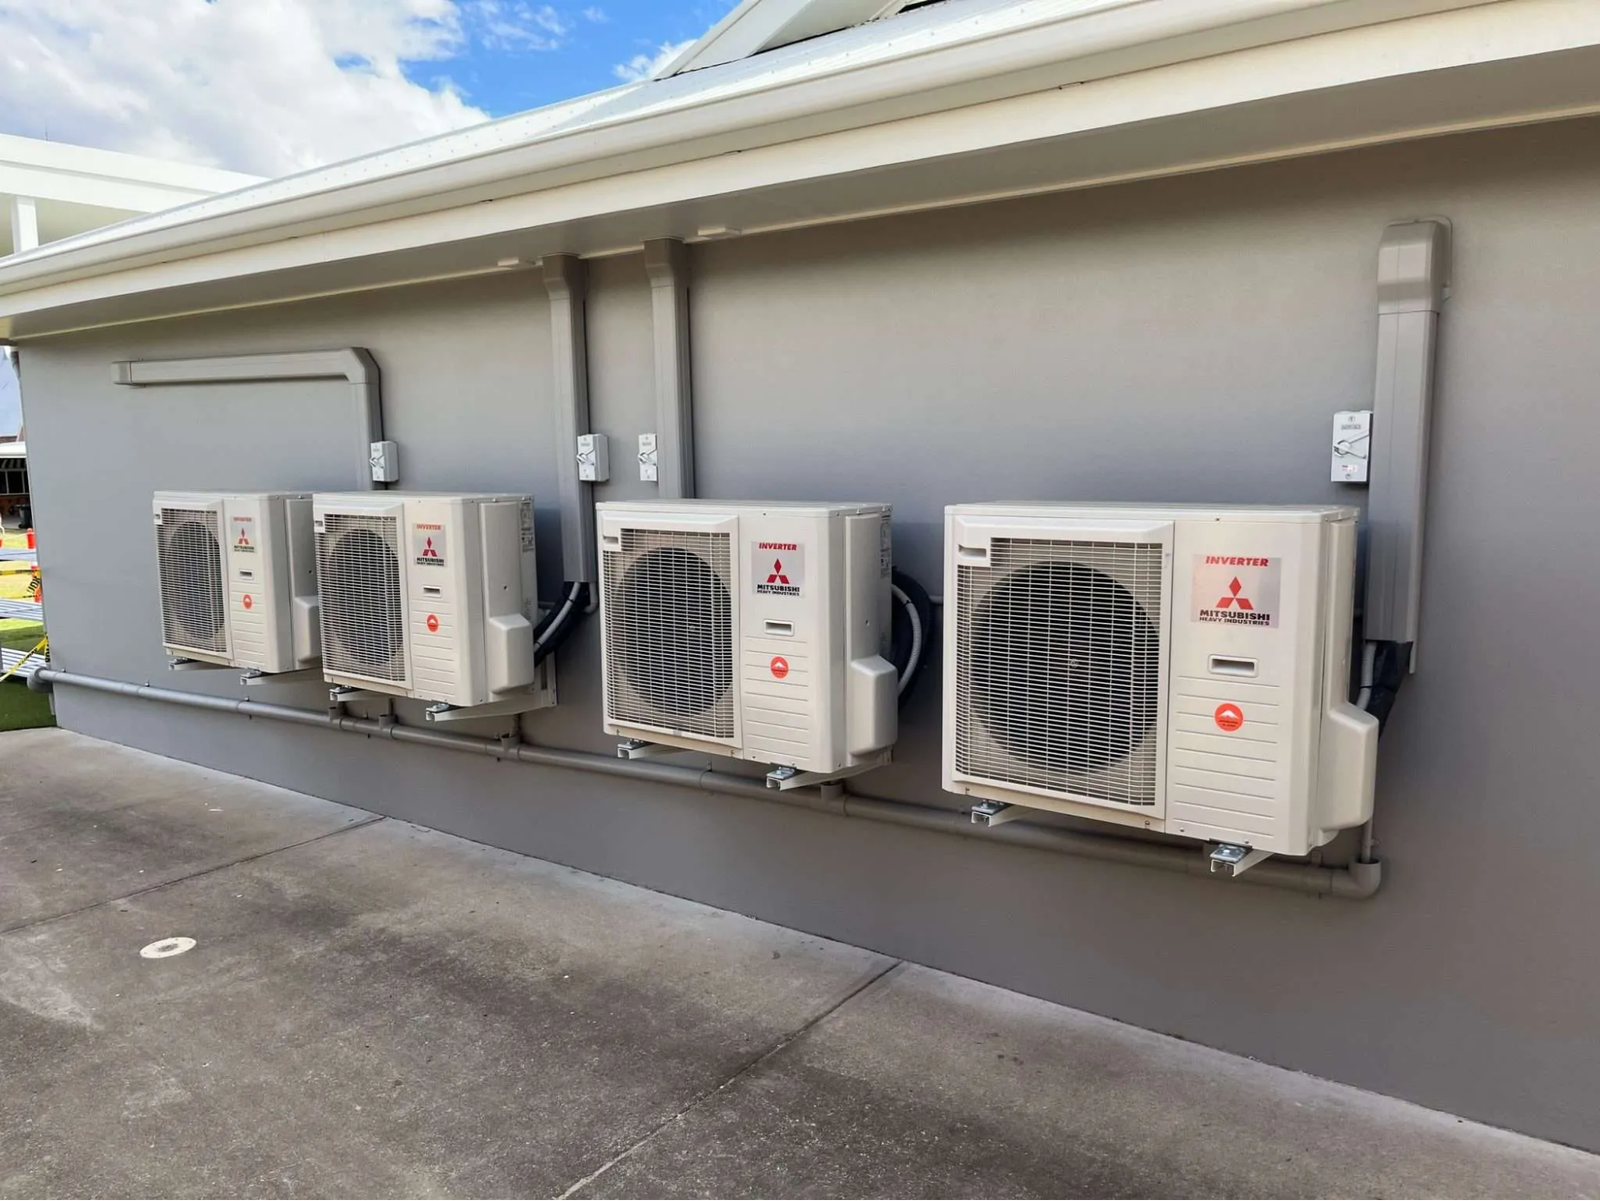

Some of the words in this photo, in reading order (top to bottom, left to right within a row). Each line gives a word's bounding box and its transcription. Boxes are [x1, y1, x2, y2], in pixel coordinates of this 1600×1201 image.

[759, 542, 797, 550] INVERTER
[1206, 556, 1269, 566] INVERTER
[757, 584, 800, 592] MITSUBISHI
[1200, 610, 1270, 620] MITSUBISHI
